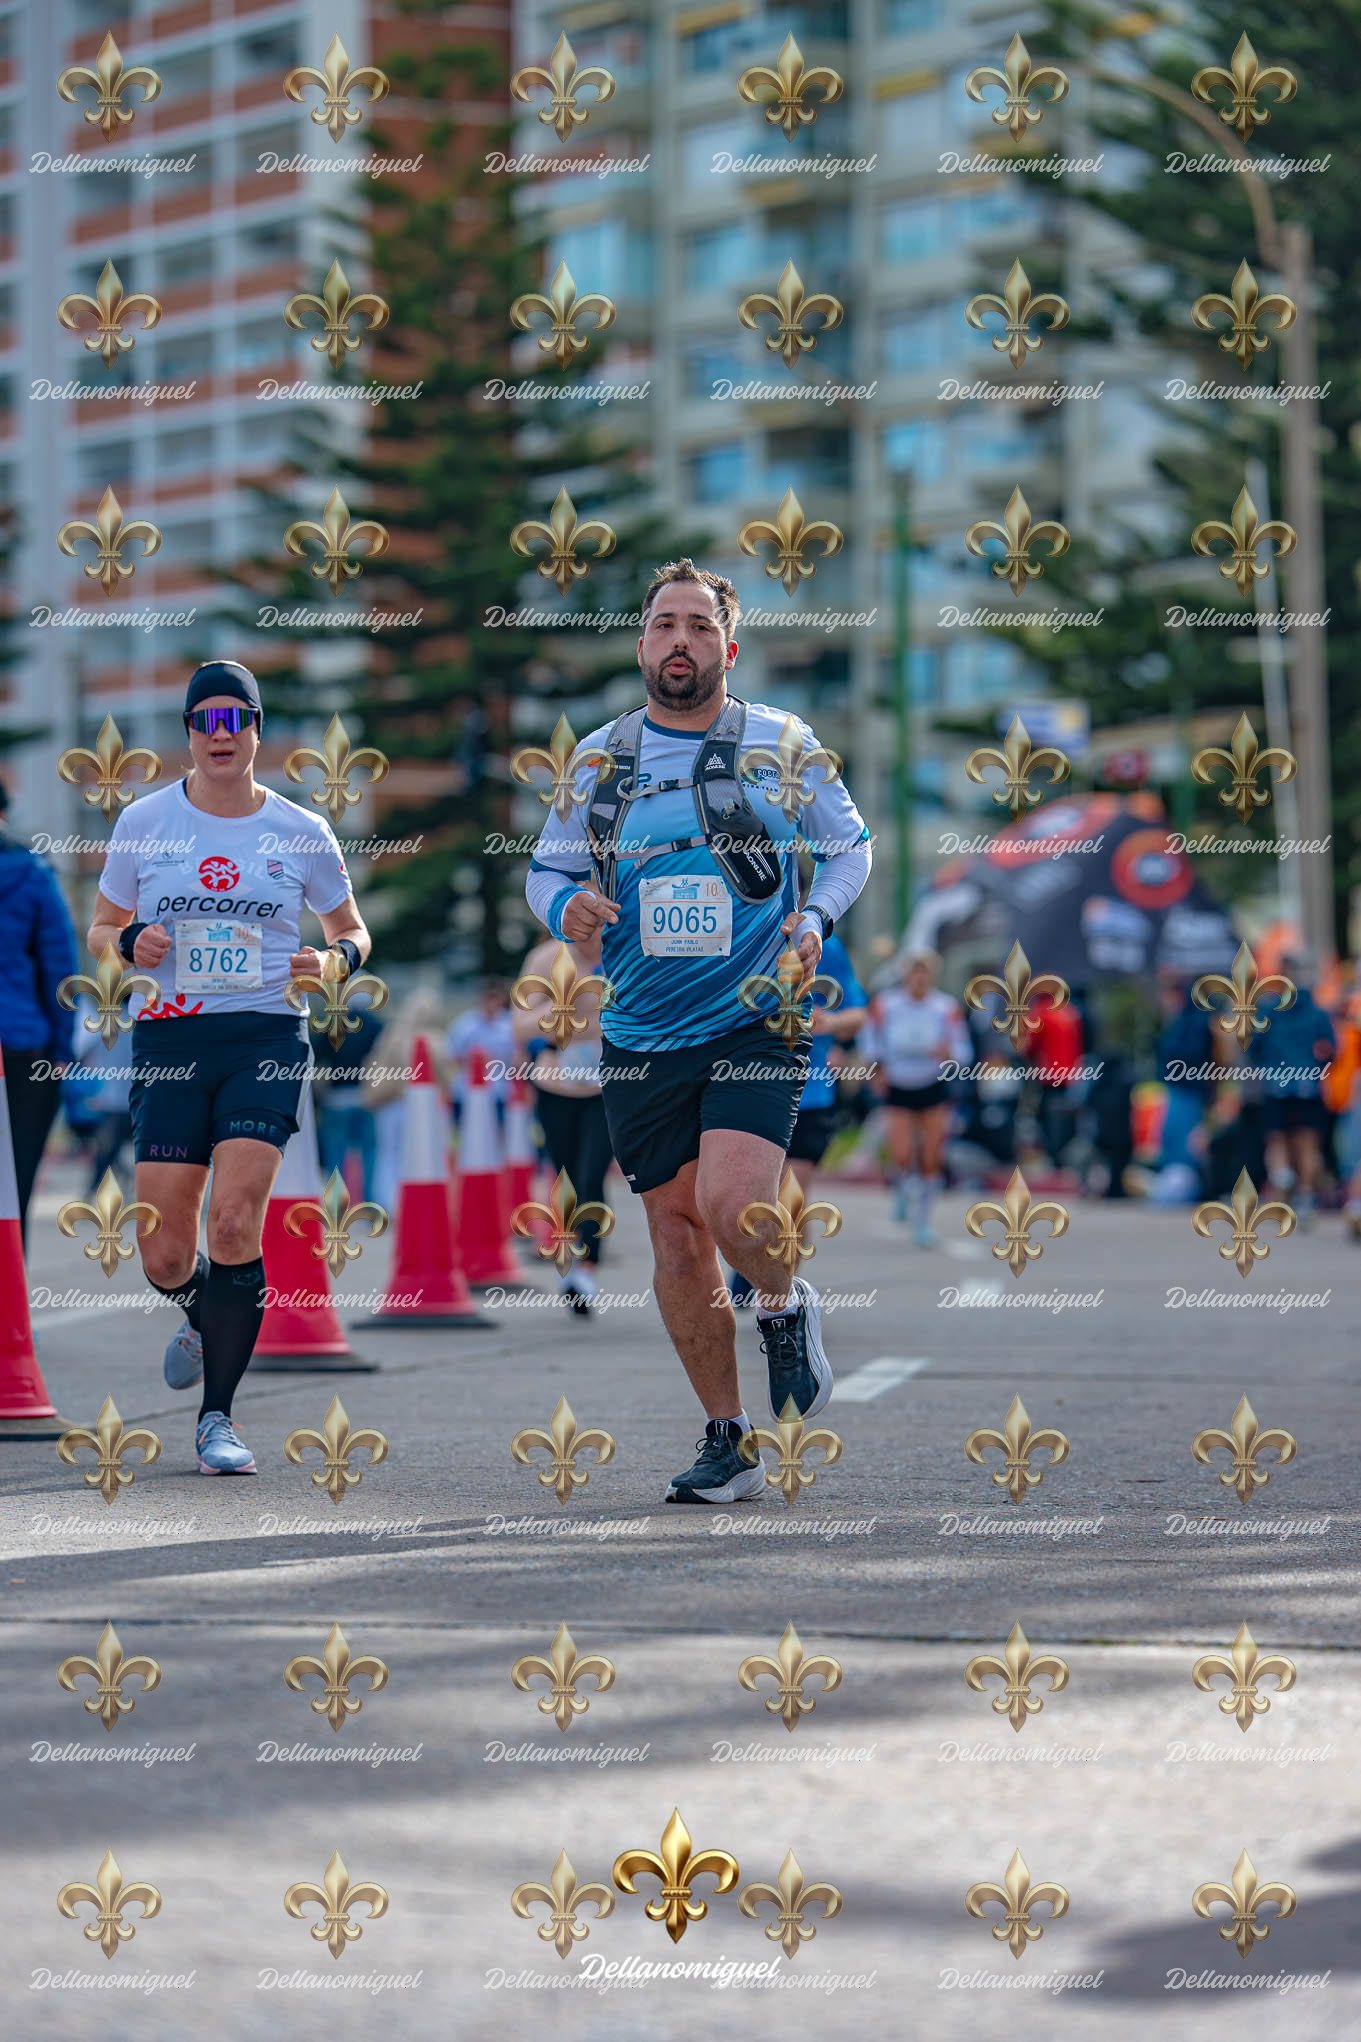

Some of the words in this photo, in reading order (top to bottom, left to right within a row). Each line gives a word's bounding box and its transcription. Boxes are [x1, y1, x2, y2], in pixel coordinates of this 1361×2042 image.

[156, 896, 283, 918] percorrer
[653, 906, 717, 934] 9065
[189, 947, 248, 973] 8762
[230, 1120, 278, 1137] MORE
[150, 1144, 188, 1159] RUN
